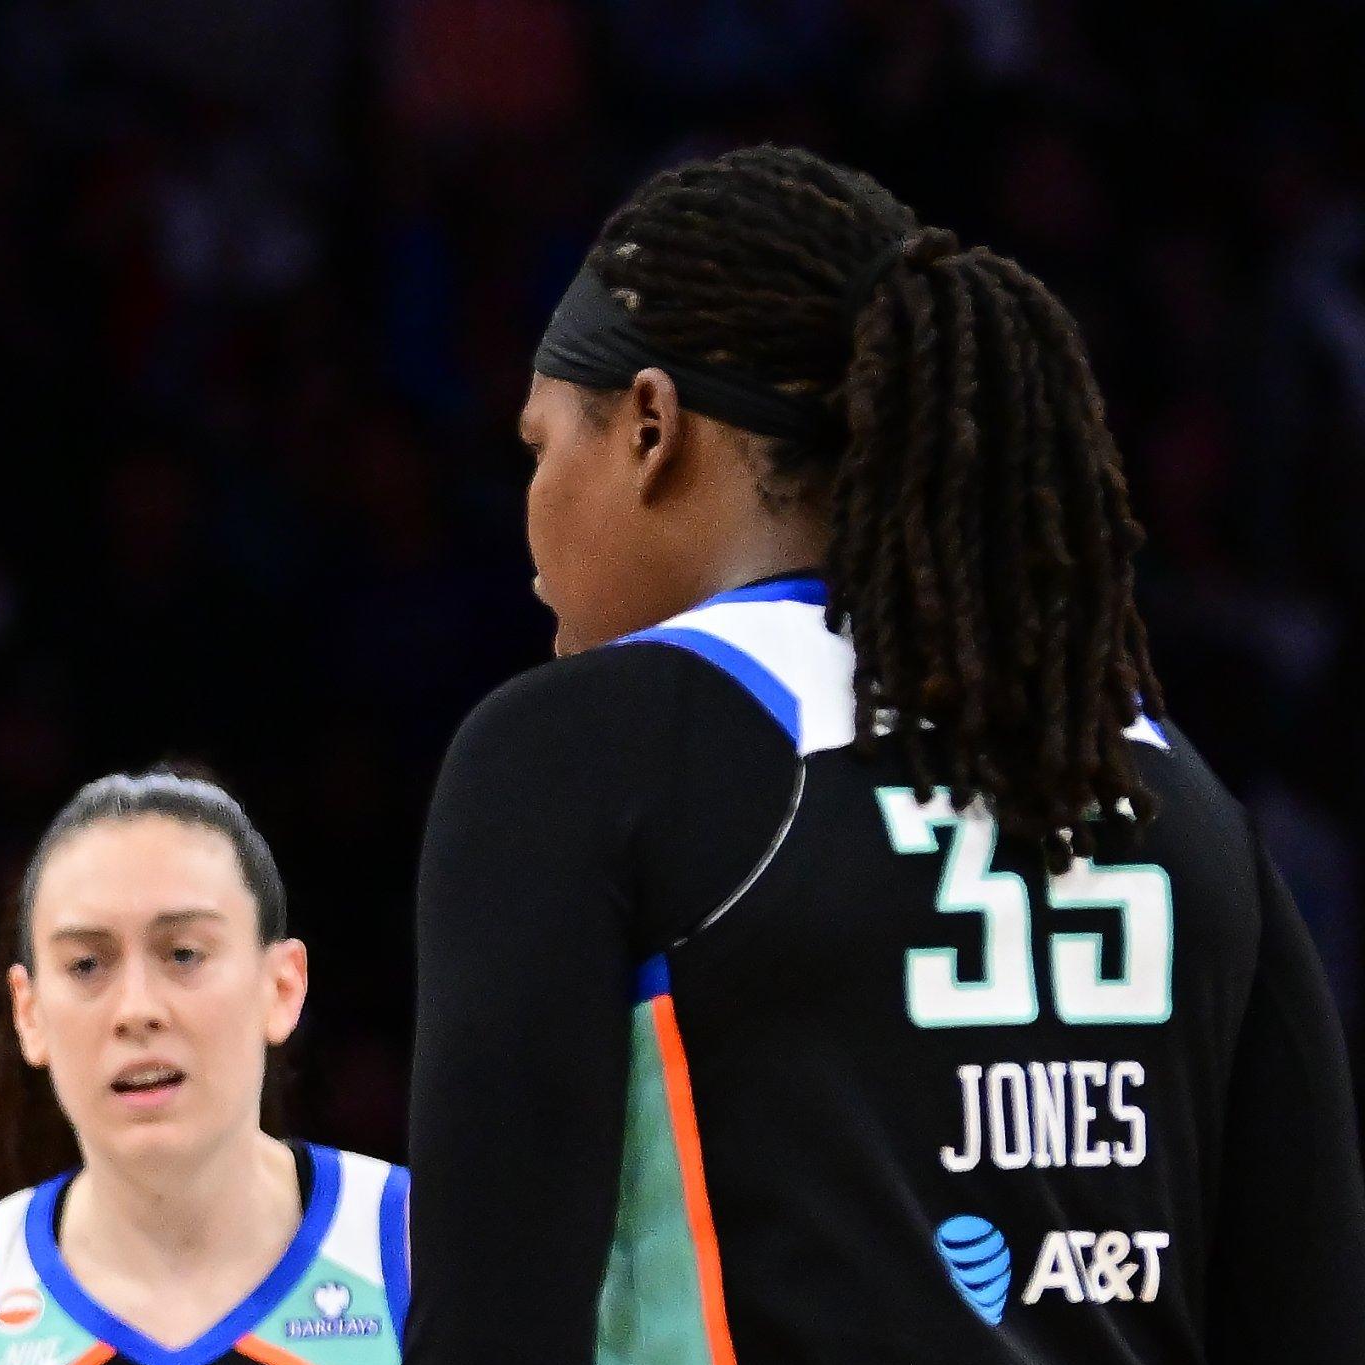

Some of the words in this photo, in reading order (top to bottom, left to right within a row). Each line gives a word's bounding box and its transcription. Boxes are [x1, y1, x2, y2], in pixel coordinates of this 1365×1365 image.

[874, 786, 1172, 1029] 35
[939, 1060, 1147, 1173] JONES
[1021, 1229, 1170, 1305] AT&T
